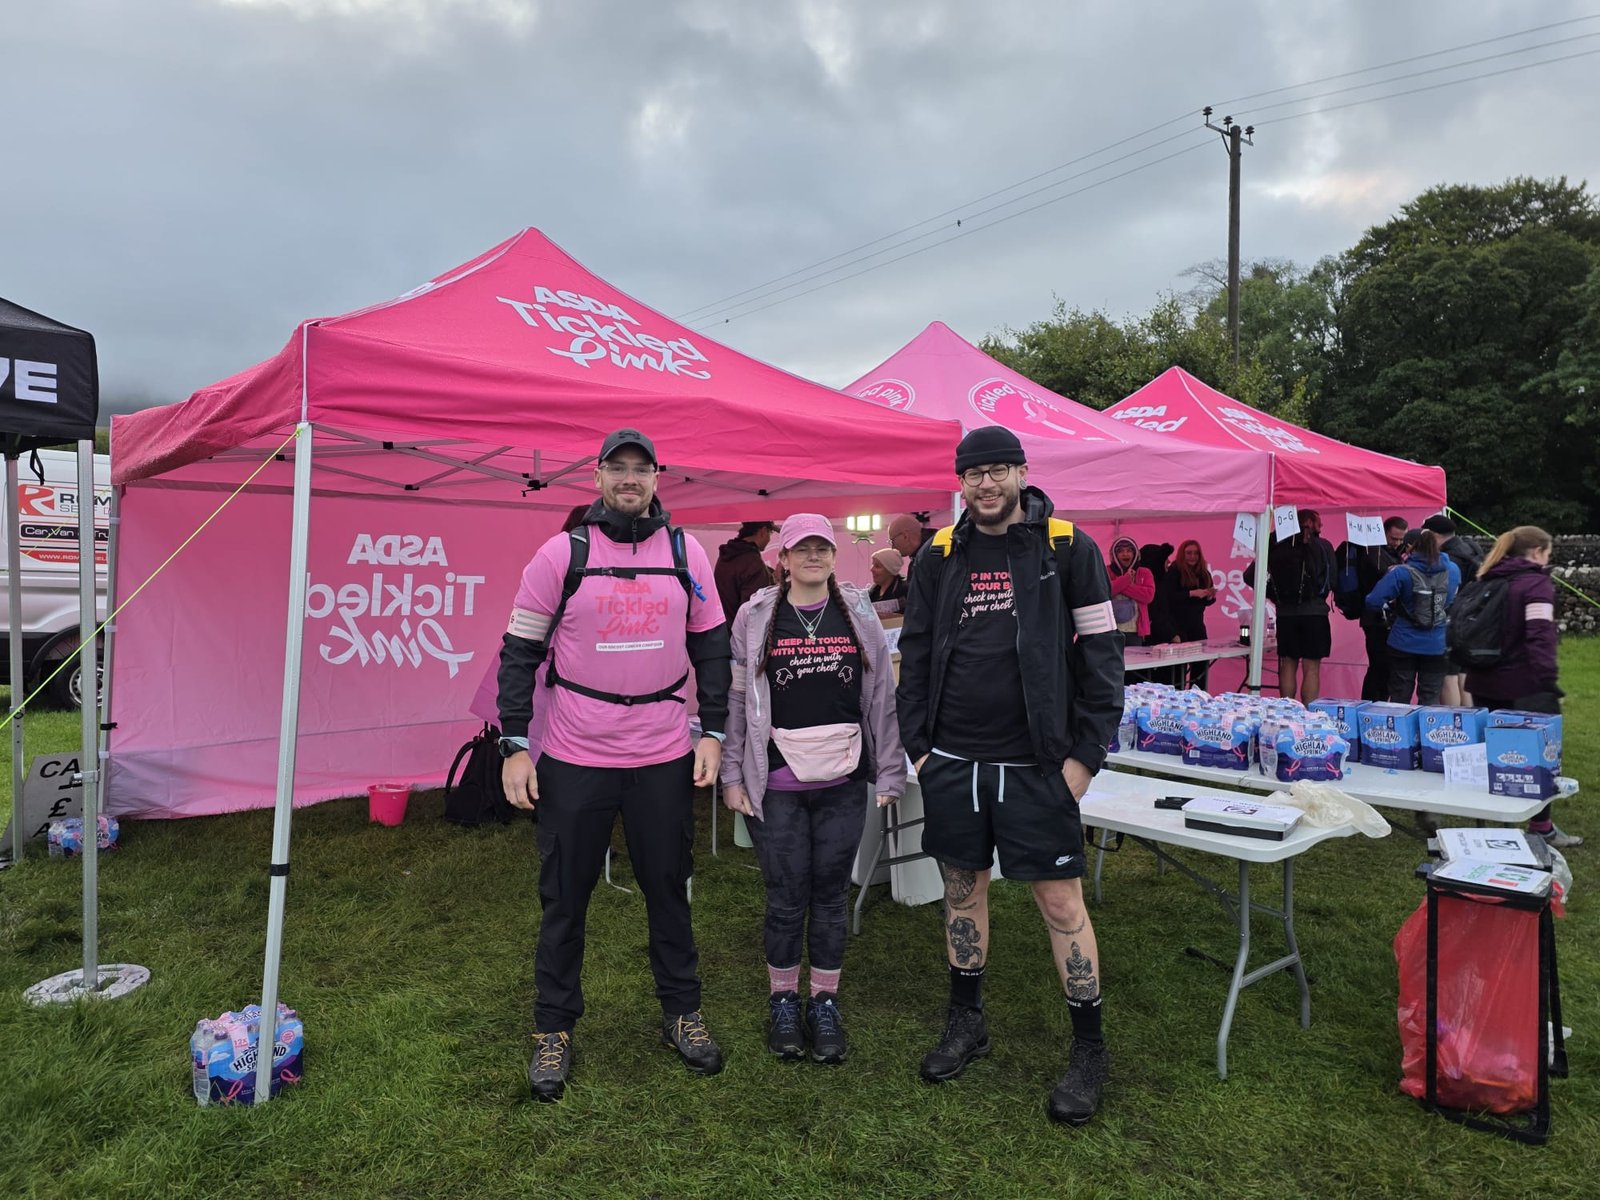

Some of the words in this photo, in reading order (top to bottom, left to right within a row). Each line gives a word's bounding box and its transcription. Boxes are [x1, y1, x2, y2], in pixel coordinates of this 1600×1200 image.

[533, 285, 641, 326] ASDA
[496, 295, 709, 362] Tickled
[546, 336, 712, 380] Pink
[1111, 405, 1167, 420] ASDA
[612, 582, 652, 594] ASDA
[971, 582, 1001, 591] YOUR
[964, 591, 986, 604] check
[987, 593, 996, 601] in
[595, 596, 669, 616] Tickled
[970, 604, 989, 618] your
[990, 598, 1015, 611] chest
[596, 614, 660, 641] Pink
[777, 638, 803, 647] KEEP
[817, 636, 850, 645] TOUCH
[770, 647, 796, 657] WITH
[797, 645, 826, 655] YOUR
[827, 645, 857, 654] BOOBS
[789, 655, 813, 667] check
[813, 654, 825, 664] in
[823, 651, 844, 662] with
[796, 667, 816, 679] your
[816, 661, 839, 673] chest
[1196, 729, 1232, 741] HIGHLAND
